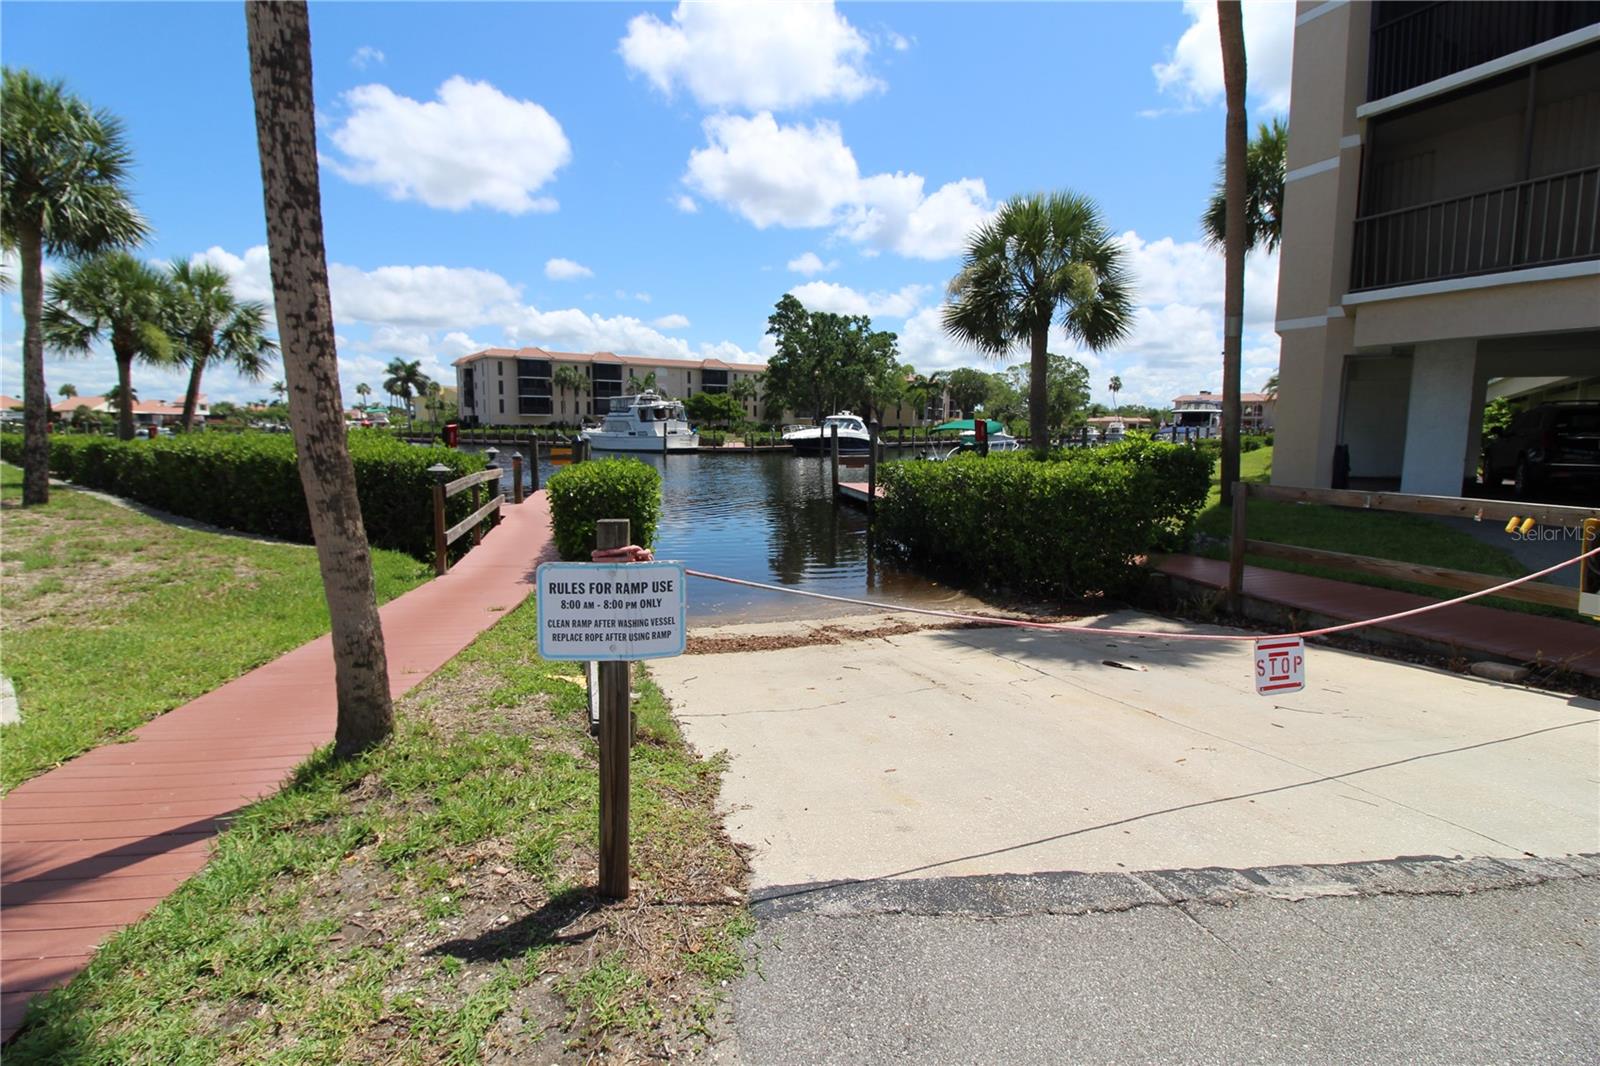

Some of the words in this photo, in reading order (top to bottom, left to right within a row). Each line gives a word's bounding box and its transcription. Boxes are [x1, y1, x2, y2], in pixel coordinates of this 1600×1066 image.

[549, 582, 585, 595] RULES
[589, 582, 611, 594] FOR
[616, 581, 648, 594] RAMP
[652, 580, 673, 593] USE
[560, 600, 581, 609] 8:00
[603, 599, 623, 609] 8:00
[625, 601, 637, 609] PM
[639, 598, 662, 609] ONLY
[547, 619, 570, 628] CLEAN
[571, 618, 593, 628] RAMP
[594, 618, 616, 628] AFTER
[618, 618, 649, 628] WASHING
[650, 616, 676, 627] VESSEL
[552, 633, 583, 642] REPLACE
[585, 633, 603, 642] ROPE
[605, 632, 627, 642] AFTER
[629, 632, 650, 642] USING
[651, 630, 672, 640] RAMP
[1256, 655, 1302, 677] STOP
